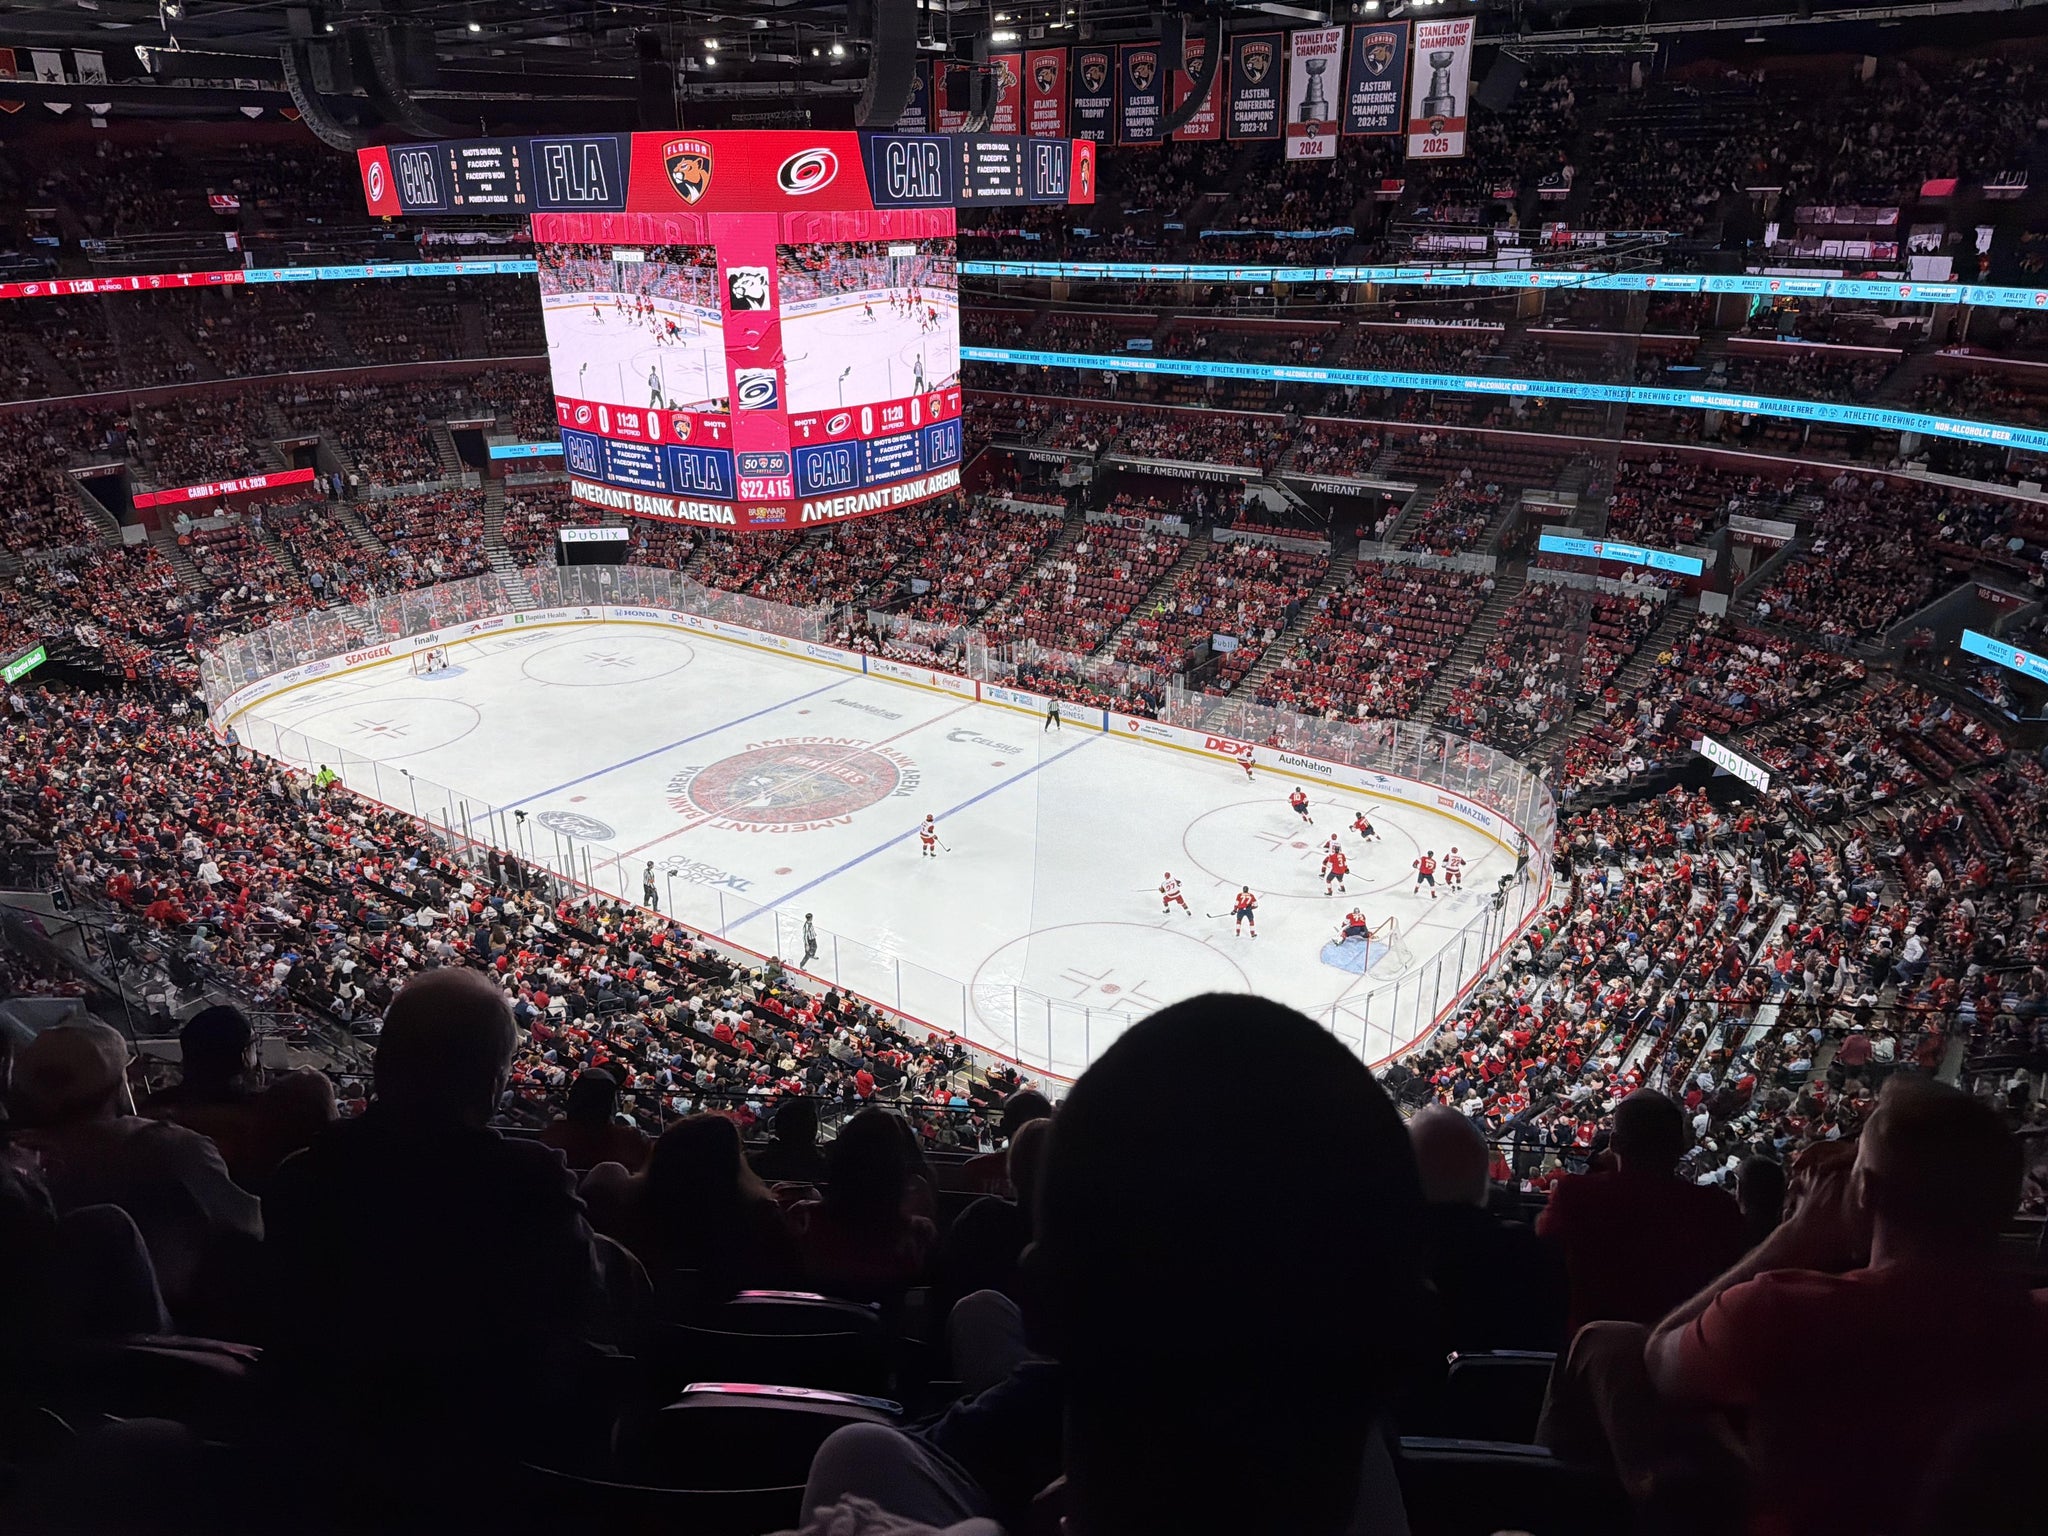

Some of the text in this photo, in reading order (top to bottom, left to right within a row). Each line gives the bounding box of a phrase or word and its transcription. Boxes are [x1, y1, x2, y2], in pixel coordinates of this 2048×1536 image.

[1419, 23, 1470, 38] STANLEY CUP
[1295, 32, 1340, 46] STANLEY CUP
[1420, 36, 1466, 49] CHAMPIONS
[1296, 44, 1337, 56] CHAMPIONS
[1360, 81, 1392, 92] EASTERN
[1241, 88, 1270, 98] EASTERN
[1352, 92, 1397, 103] CONFERENCE
[1034, 99, 1058, 109] ATLANTIC
[1075, 98, 1112, 107] PRESIDENTS'
[1130, 96, 1154, 105] EASTERN
[1234, 100, 1276, 110] CONFERENCE
[1034, 110, 1057, 119] DIVISION
[1082, 109, 1105, 118] TROPHY
[1125, 107, 1159, 115] CONFERENCE
[1235, 110, 1274, 121] CHAMPIONS
[1352, 104, 1395, 115] CHAMPIONS
[1031, 120, 1060, 129] CHAMPIONS
[1239, 122, 1268, 133] 2023-24
[1357, 116, 1388, 127] 2024-25
[1081, 131, 1105, 139] 2021-22
[1130, 128, 1153, 137] 2022-23
[1184, 124, 1209, 134] 2023-24
[666, 143, 707, 155] FLORIDA
[1299, 141, 1323, 155] 2024
[1423, 138, 1449, 153] 2025
[544, 145, 609, 201] FLA
[886, 142, 941, 198] CAR
[1037, 145, 1064, 194] FLA
[399, 153, 438, 205] CAR
[50, 281, 94, 294] 0 11:20
[132, 278, 138, 288] 0
[2003, 292, 2026, 300] ATHLETIC
[1056, 356, 1078, 365] ATHLETIC
[1079, 358, 1099, 366] BREWING
[1181, 364, 1192, 372] HERE
[1211, 366, 1370, 382] ATHLETIC BREWING NON-ALCOHOLIC BEER AVAILABLE HERE
[1392, 376, 1577, 395] ATHLETIC BREWING NON-ALCOHOLIC BEER AVAILABLE HERE
[1604, 388, 1814, 415] ATHLETIC BREWING NON-ALCOHOLIC BEER AVAILABLE HERE
[598, 405, 660, 440] 0 11:20 0
[794, 418, 816, 426] SHOTS
[861, 398, 920, 435] 0 11:20 0
[704, 420, 726, 428] SHOTS
[1843, 410, 2010, 440] ATHLETIC BREWING NON-ALCOHOLIC BEER
[713, 428, 719, 440] 4
[803, 426, 810, 438] 3
[932, 426, 956, 463] FLA
[568, 436, 596, 473] CAR
[1029, 452, 1066, 464] AMERANT
[744, 458, 782, 470] 50 50
[807, 450, 850, 488] CAR
[678, 453, 723, 492] FLA
[1136, 464, 1230, 483] THE AMERANT VAULT
[188, 486, 208, 498] CARDI
[208, 486, 214, 496] B
[239, 480, 248, 491] 14,
[740, 480, 790, 500] $22,415
[1311, 482, 1362, 496] AMERANT
[801, 468, 960, 523] AMERANT BANK ARENA
[571, 480, 736, 526] AMERANT BANK ARENA
[568, 531, 618, 540] Publix
[1734, 532, 1746, 542] 104
[1772, 539, 1786, 548] 105
[1978, 588, 1990, 600] 105
[526, 614, 546, 622] Baptist
[624, 610, 659, 618] HONDA
[672, 613, 684, 622] C4
[690, 617, 702, 626] C4
[414, 634, 439, 646] finally
[1986, 643, 2008, 656] ATHLETIC
[346, 646, 392, 666] SEATGEEK
[833, 698, 903, 720] AutoNation
[1056, 700, 1084, 712] OMCAST
[1056, 709, 1084, 720] USINESS
[971, 735, 1024, 755] CELSIUS
[745, 736, 920, 798] AMERANT BANK ARENA
[1279, 754, 1332, 774] AutoNation
[1708, 742, 1758, 784] Publix
[782, 756, 872, 784] PANTHERS
[1360, 779, 1402, 794] Disney CRUISE LINE
[666, 765, 852, 834] AMERANT BANK ARENA
[1454, 802, 1490, 826] AMAZING
[547, 815, 601, 838] Ford
[1338, 858, 1343, 867] 3
[1452, 858, 1460, 867] 22
[668, 855, 754, 892] OMEGA XL
[1240, 896, 1252, 905] 77
